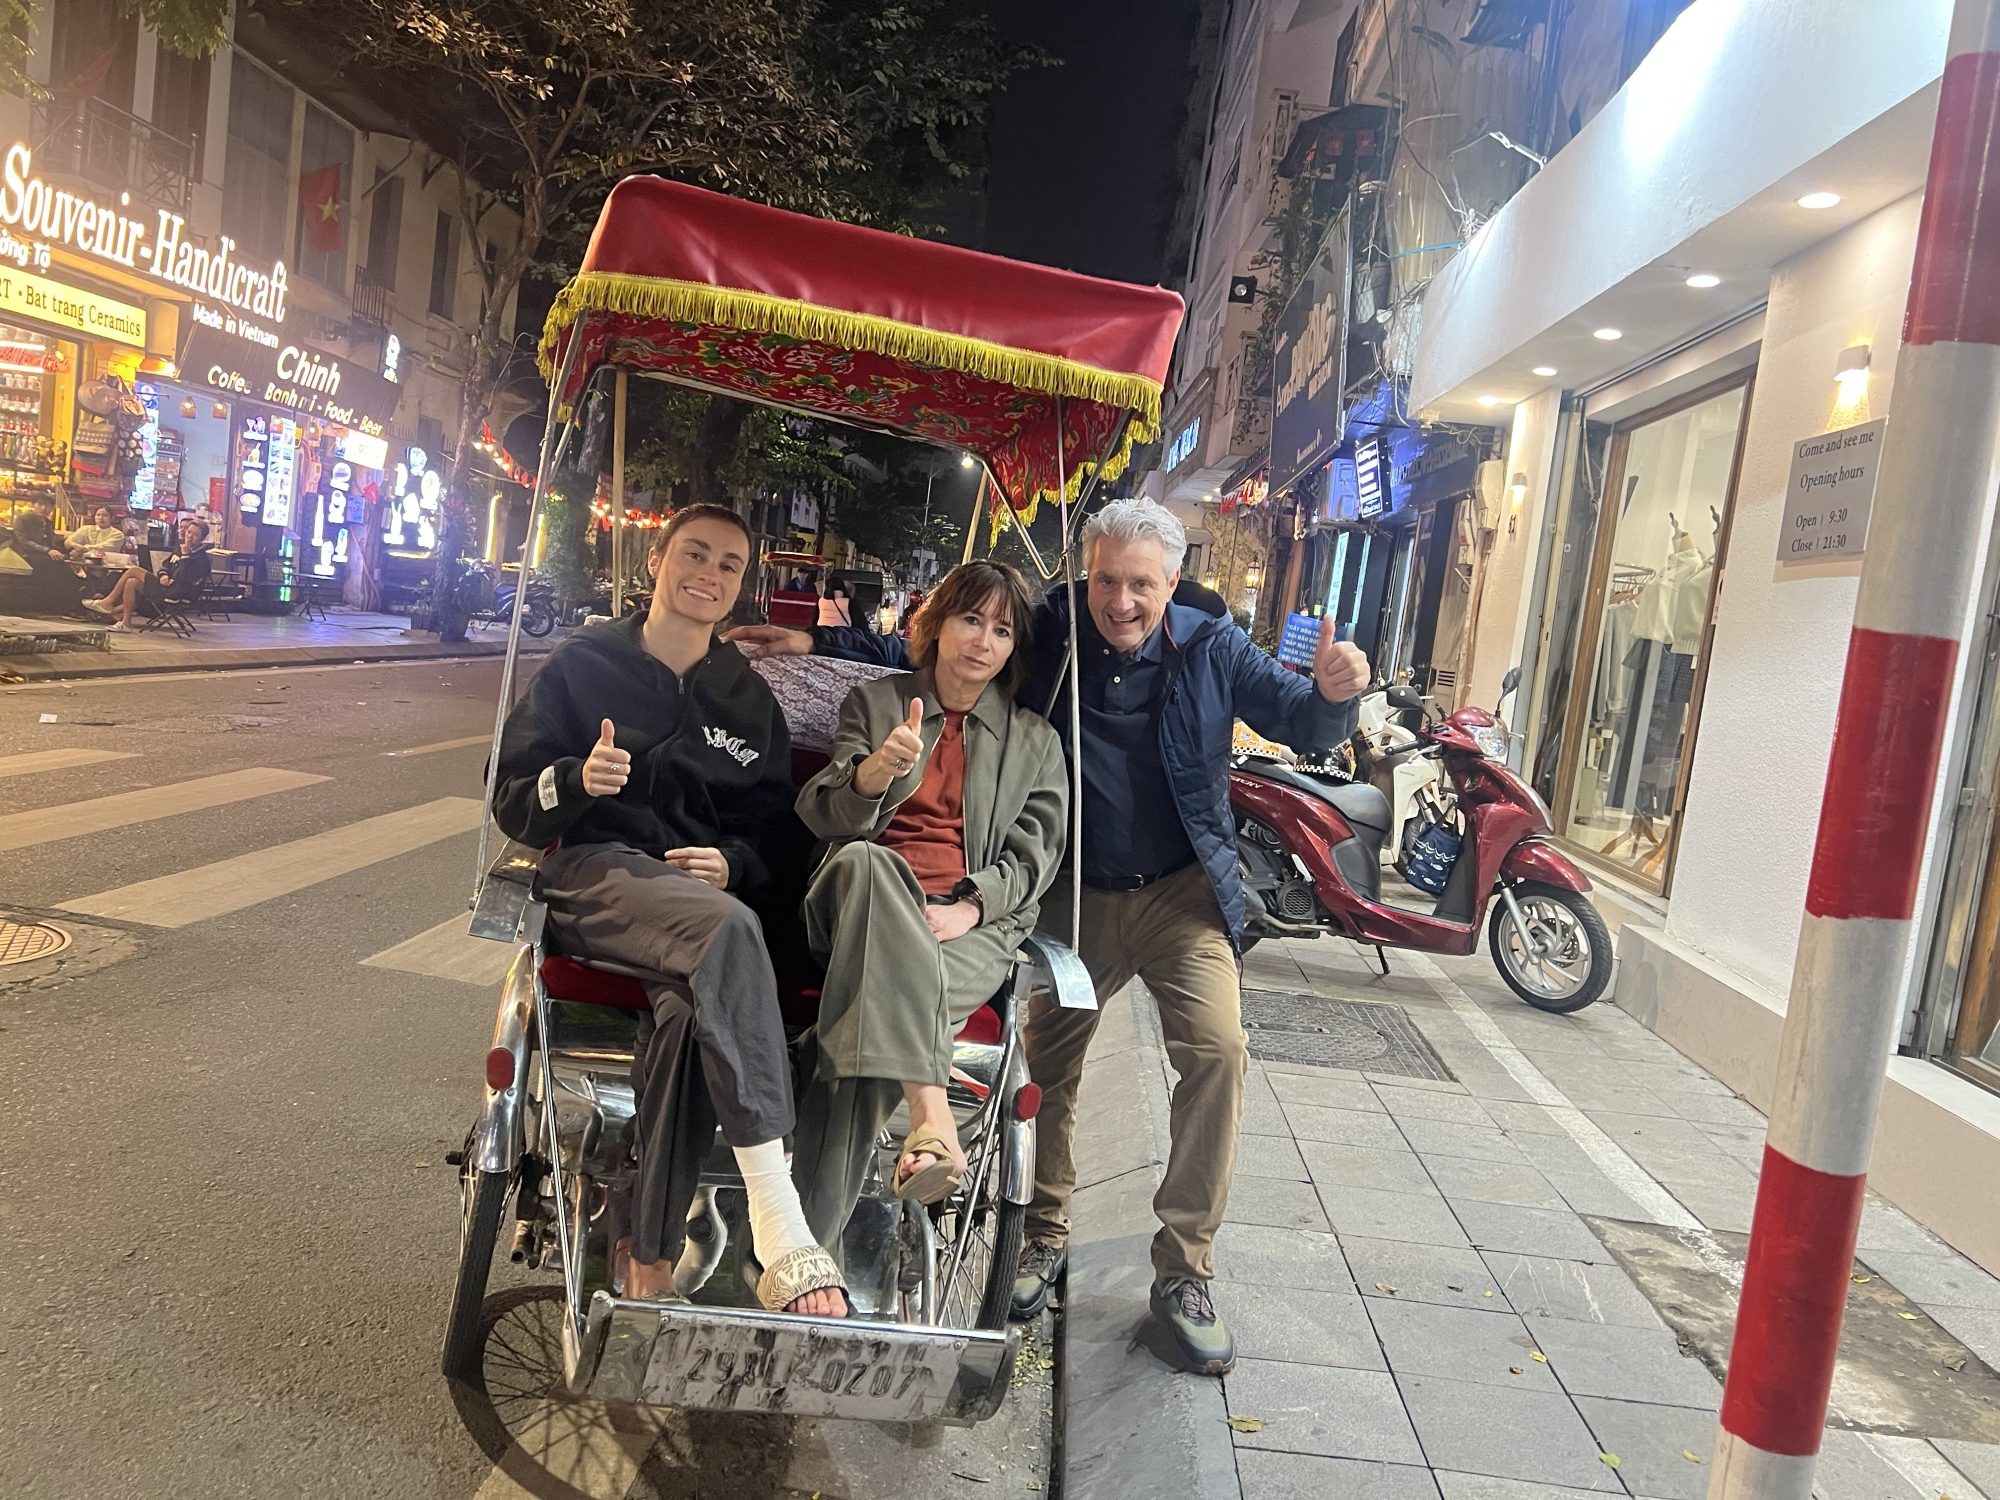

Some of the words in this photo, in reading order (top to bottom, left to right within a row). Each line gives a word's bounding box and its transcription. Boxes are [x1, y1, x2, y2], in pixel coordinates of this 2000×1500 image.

[0, 278, 12, 299] T
[26, 285, 47, 309] Bat
[52, 295, 85, 327] trang
[89, 305, 141, 337] Ceramics
[192, 303, 224, 330] Made
[225, 315, 237, 334] in
[238, 319, 279, 350] Vietnam
[276, 345, 341, 396] Chinh
[207, 364, 253, 395] Coffee
[264, 382, 298, 408] Banh
[323, 400, 354, 425] Food
[358, 415, 384, 438] Beer
[1799, 443, 1825, 459] Come
[1825, 434, 1842, 453] and
[1843, 435, 1858, 449] see
[1859, 431, 1875, 445] me
[1800, 468, 1838, 493] Opening
[1838, 465, 1865, 481] hours
[1795, 514, 1817, 532] Open
[1828, 508, 1848, 525] 9:30
[1791, 537, 1813, 553] Close
[1823, 534, 1846, 550] 21:30
[819, 1359, 918, 1400] 0207
